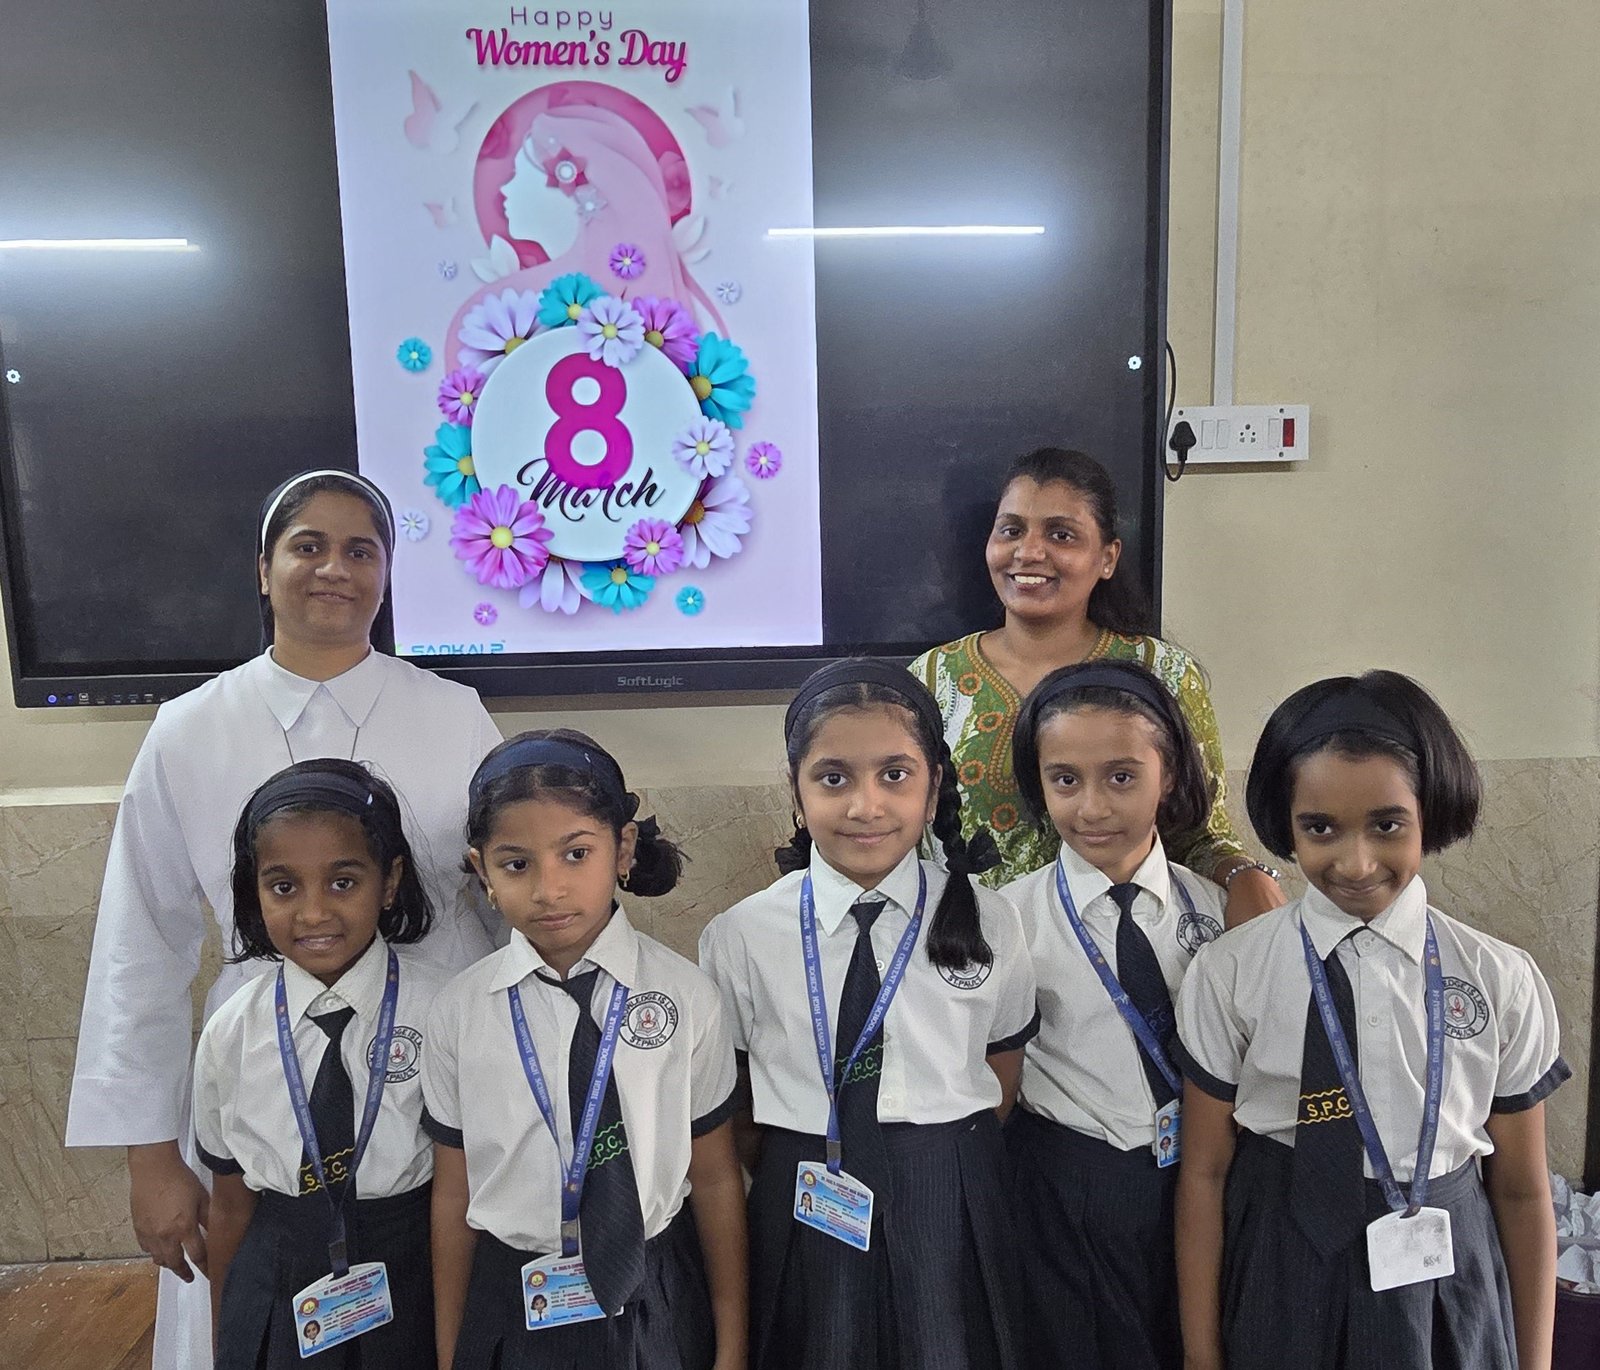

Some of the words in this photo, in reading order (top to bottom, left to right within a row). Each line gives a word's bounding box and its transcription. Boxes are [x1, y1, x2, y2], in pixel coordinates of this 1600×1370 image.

[510, 6, 614, 31] Happy
[466, 27, 610, 67] Women's
[618, 28, 687, 83] Day
[544, 352, 634, 490] 8
[516, 457, 666, 523] March
[617, 675, 685, 689] SoftLogic
[812, 994, 820, 1014] HIGH
[878, 984, 892, 1004] HIGH
[527, 1056, 539, 1075] HIGH
[581, 1101, 596, 1137] CONVENT
[591, 1079, 601, 1099] HIGH
